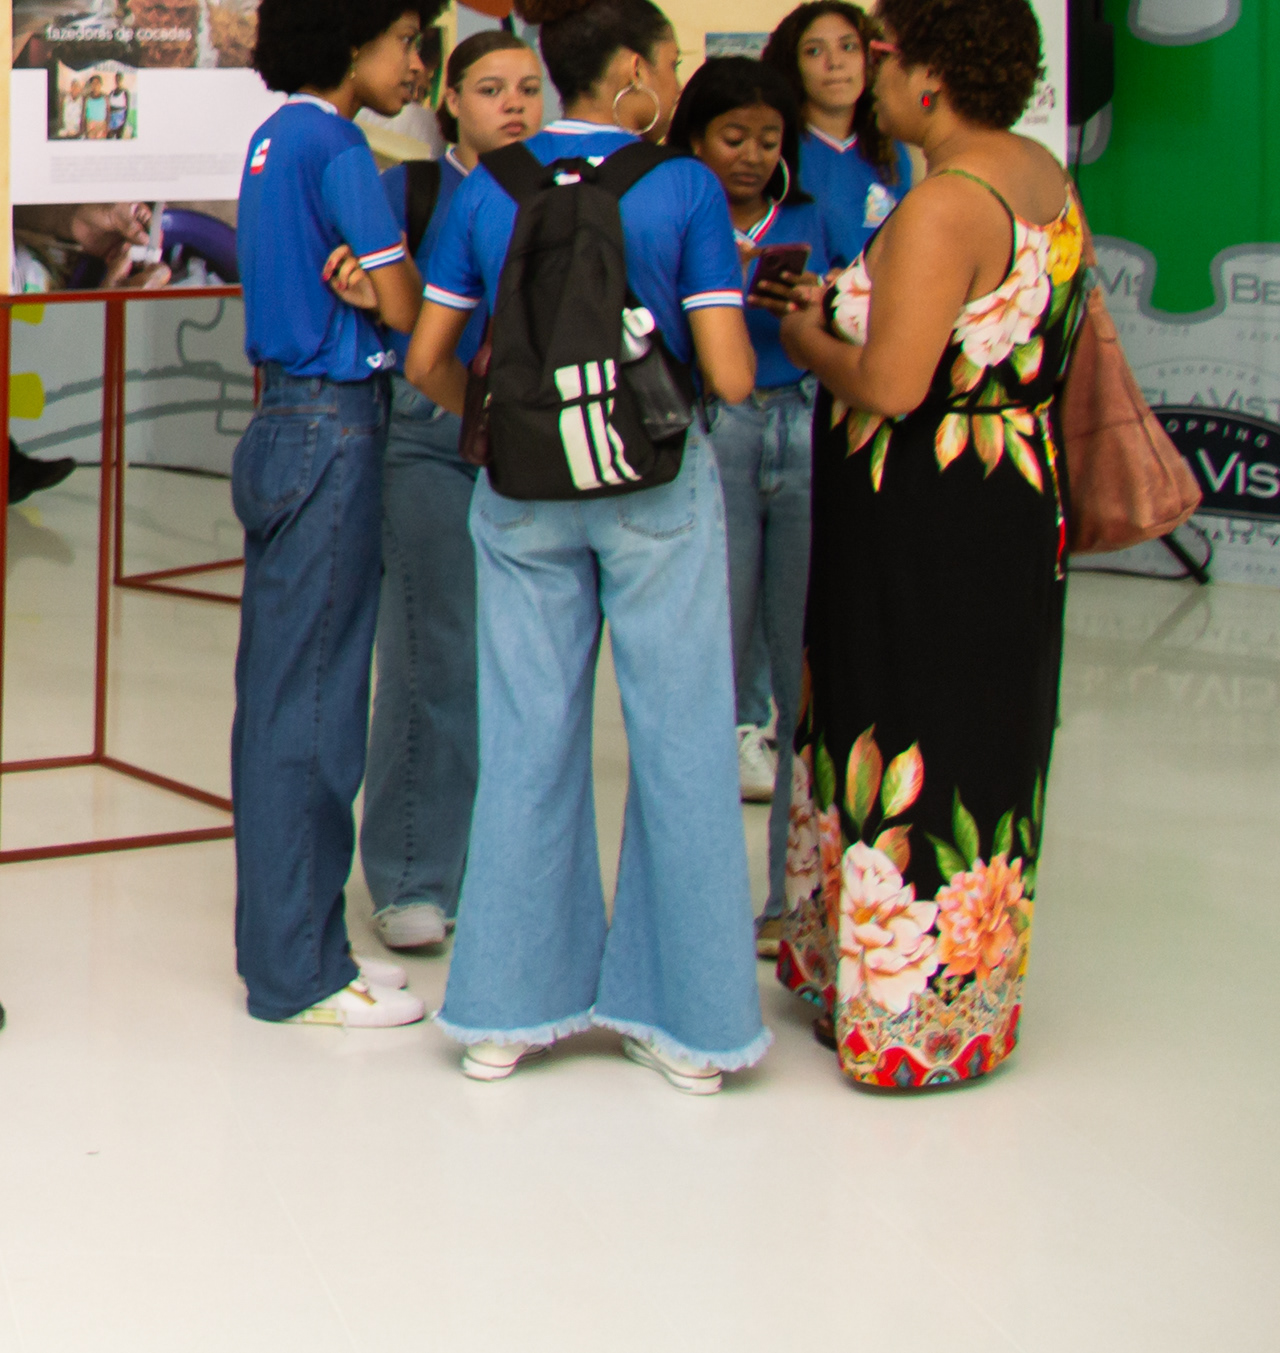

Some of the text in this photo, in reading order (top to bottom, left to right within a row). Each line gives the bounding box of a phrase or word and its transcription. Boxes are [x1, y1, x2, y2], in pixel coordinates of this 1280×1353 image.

[45, 24, 113, 42] fazedoras
[114, 26, 134, 43] de
[1165, 418, 1270, 448] OPPING
